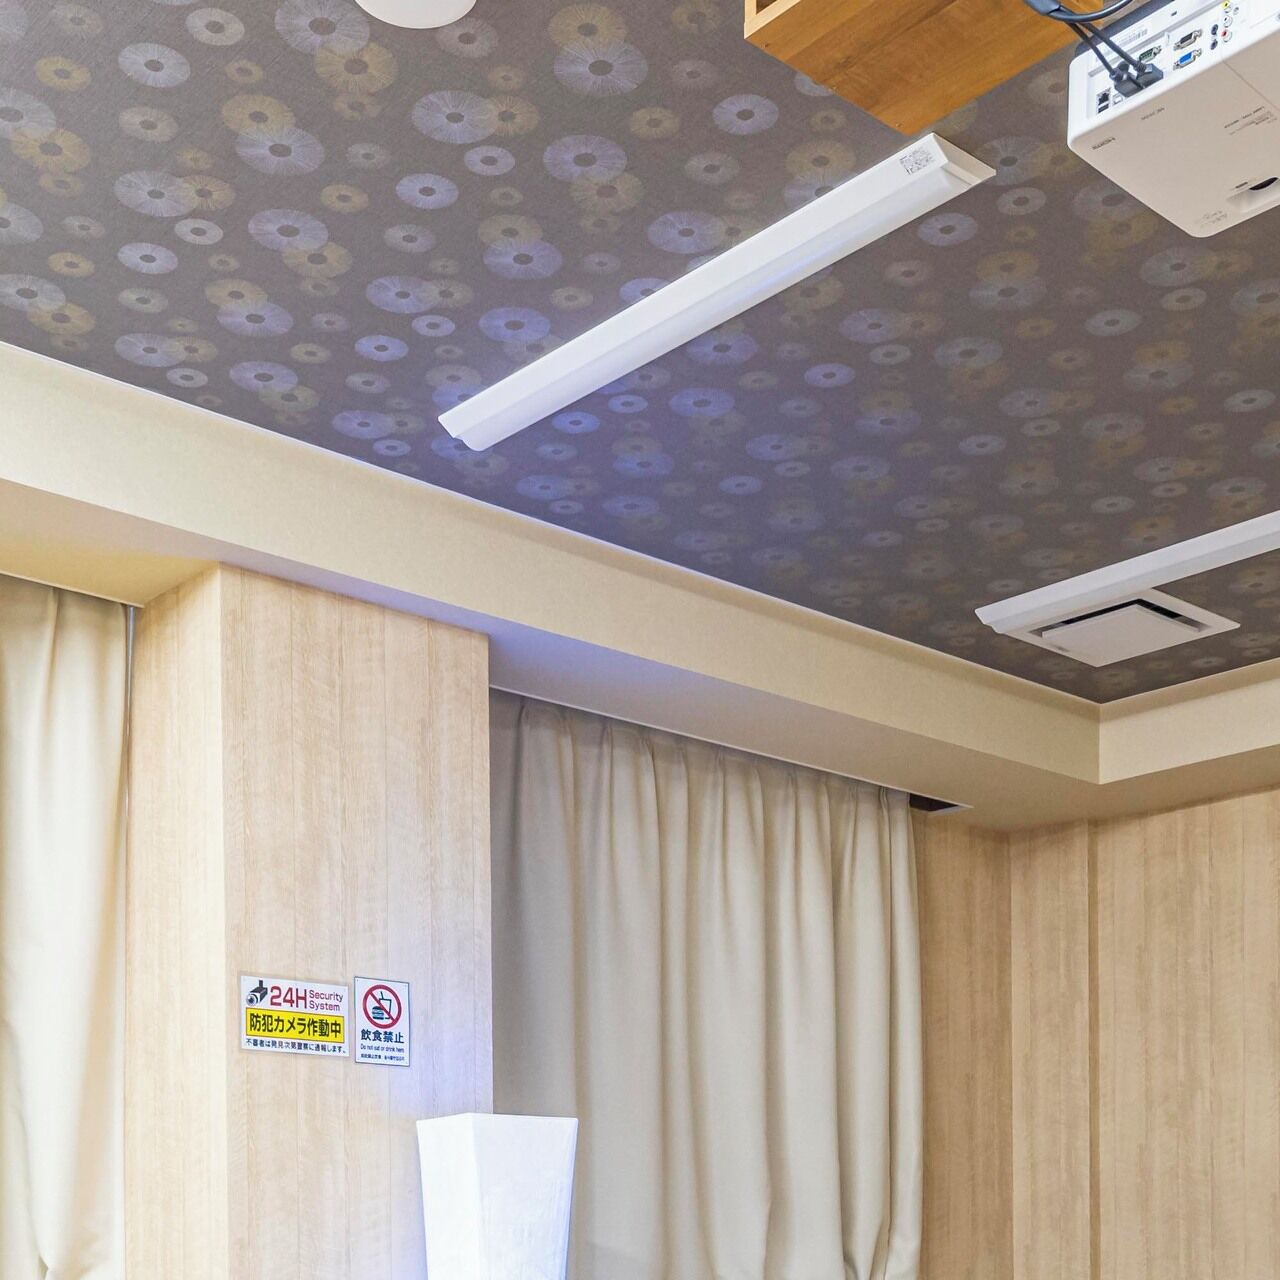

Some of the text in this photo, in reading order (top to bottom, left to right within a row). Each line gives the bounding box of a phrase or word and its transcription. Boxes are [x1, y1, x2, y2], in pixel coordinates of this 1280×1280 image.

[270, 985, 307, 1009] 24H
[309, 990, 343, 1003] Security
[309, 1001, 340, 1011] System
[250, 1013, 342, 1038] 防犯カメラ作動中
[361, 1029, 404, 1043] 飲食禁止
